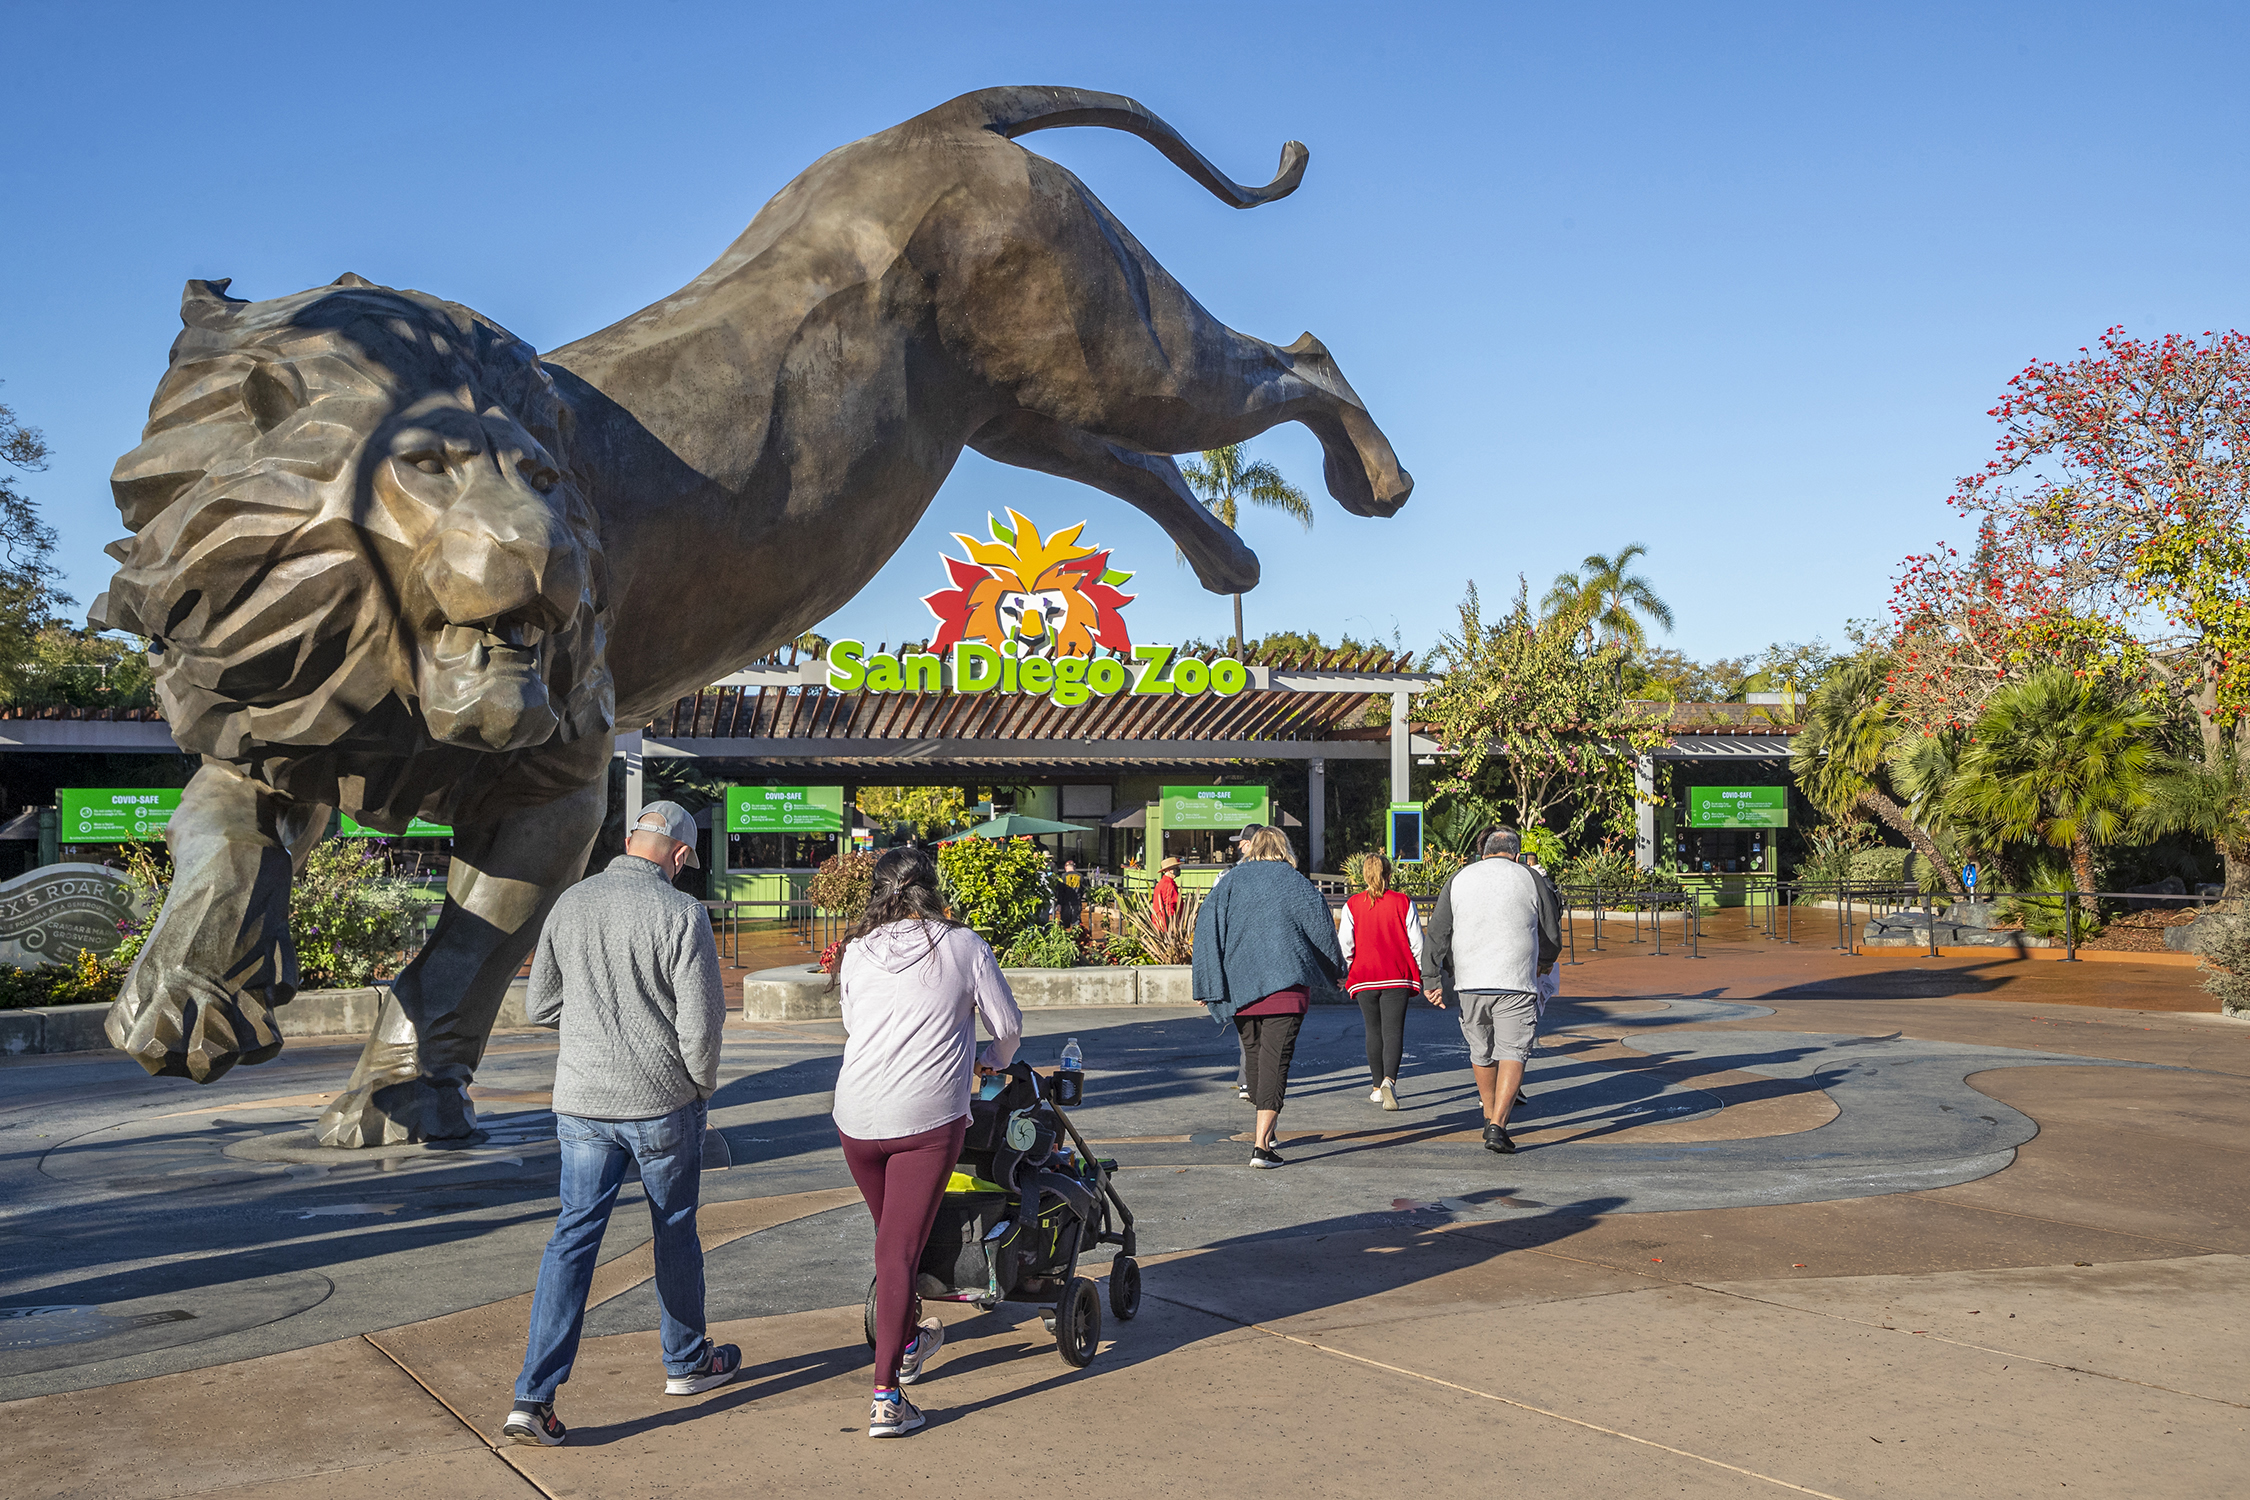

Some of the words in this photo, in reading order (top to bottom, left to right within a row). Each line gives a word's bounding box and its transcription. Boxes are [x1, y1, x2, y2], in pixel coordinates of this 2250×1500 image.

[826, 638, 942, 694] San
[953, 639, 1126, 708] Diego
[1131, 644, 1247, 697] Zoo
[765, 792, 802, 800] COVID-SAFE
[1197, 791, 1232, 799] COVID-SAFE
[1722, 791, 1752, 799] COVID-SAFE
[111, 795, 160, 805] COVID-SAFE
[730, 833, 741, 841] 10
[64, 846, 77, 855] 14
[46, 881, 106, 899] ROAR
[15, 911, 48, 928] POSSIBLE
[67, 902, 105, 912] GENEROUS
[53, 930, 108, 945] GROSVENOR
